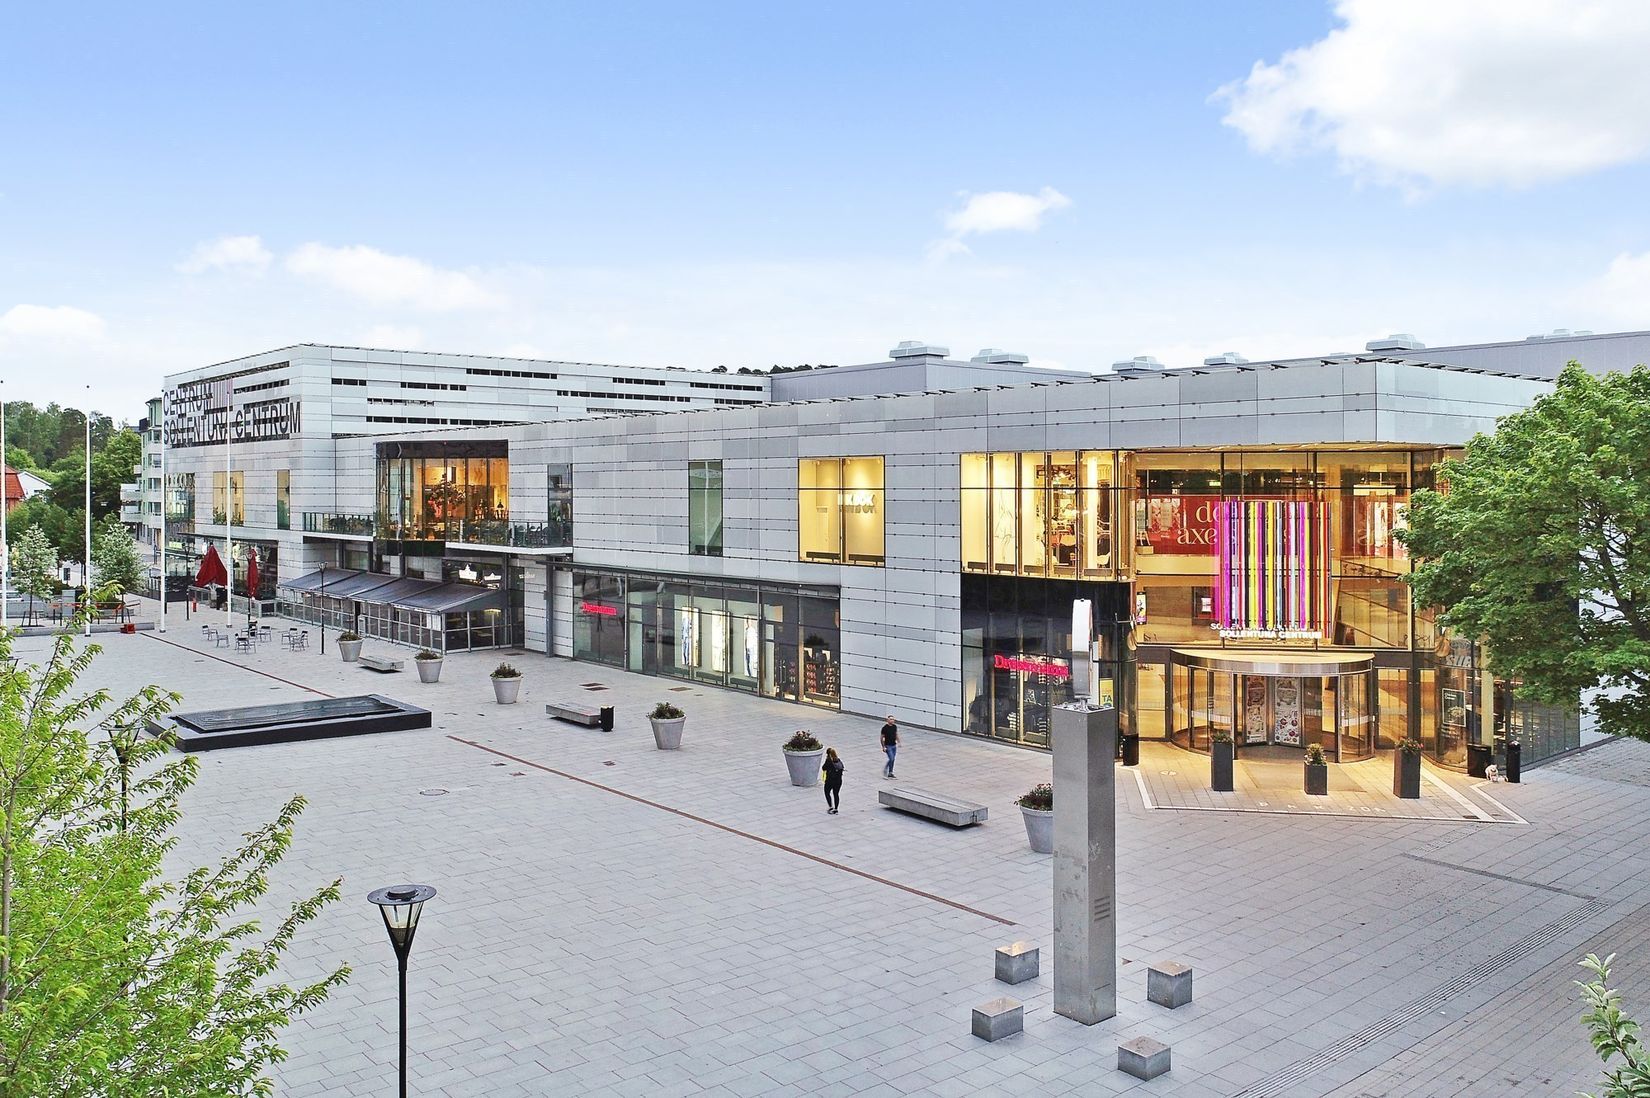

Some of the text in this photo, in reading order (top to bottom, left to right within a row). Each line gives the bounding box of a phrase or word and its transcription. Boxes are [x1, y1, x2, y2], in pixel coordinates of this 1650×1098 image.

[163, 382, 213, 416] CENTRUM
[163, 401, 301, 445] SOLLENTUNA CENTRUM
[1219, 629, 1322, 640] SOLLENTUNA CENTRUM
